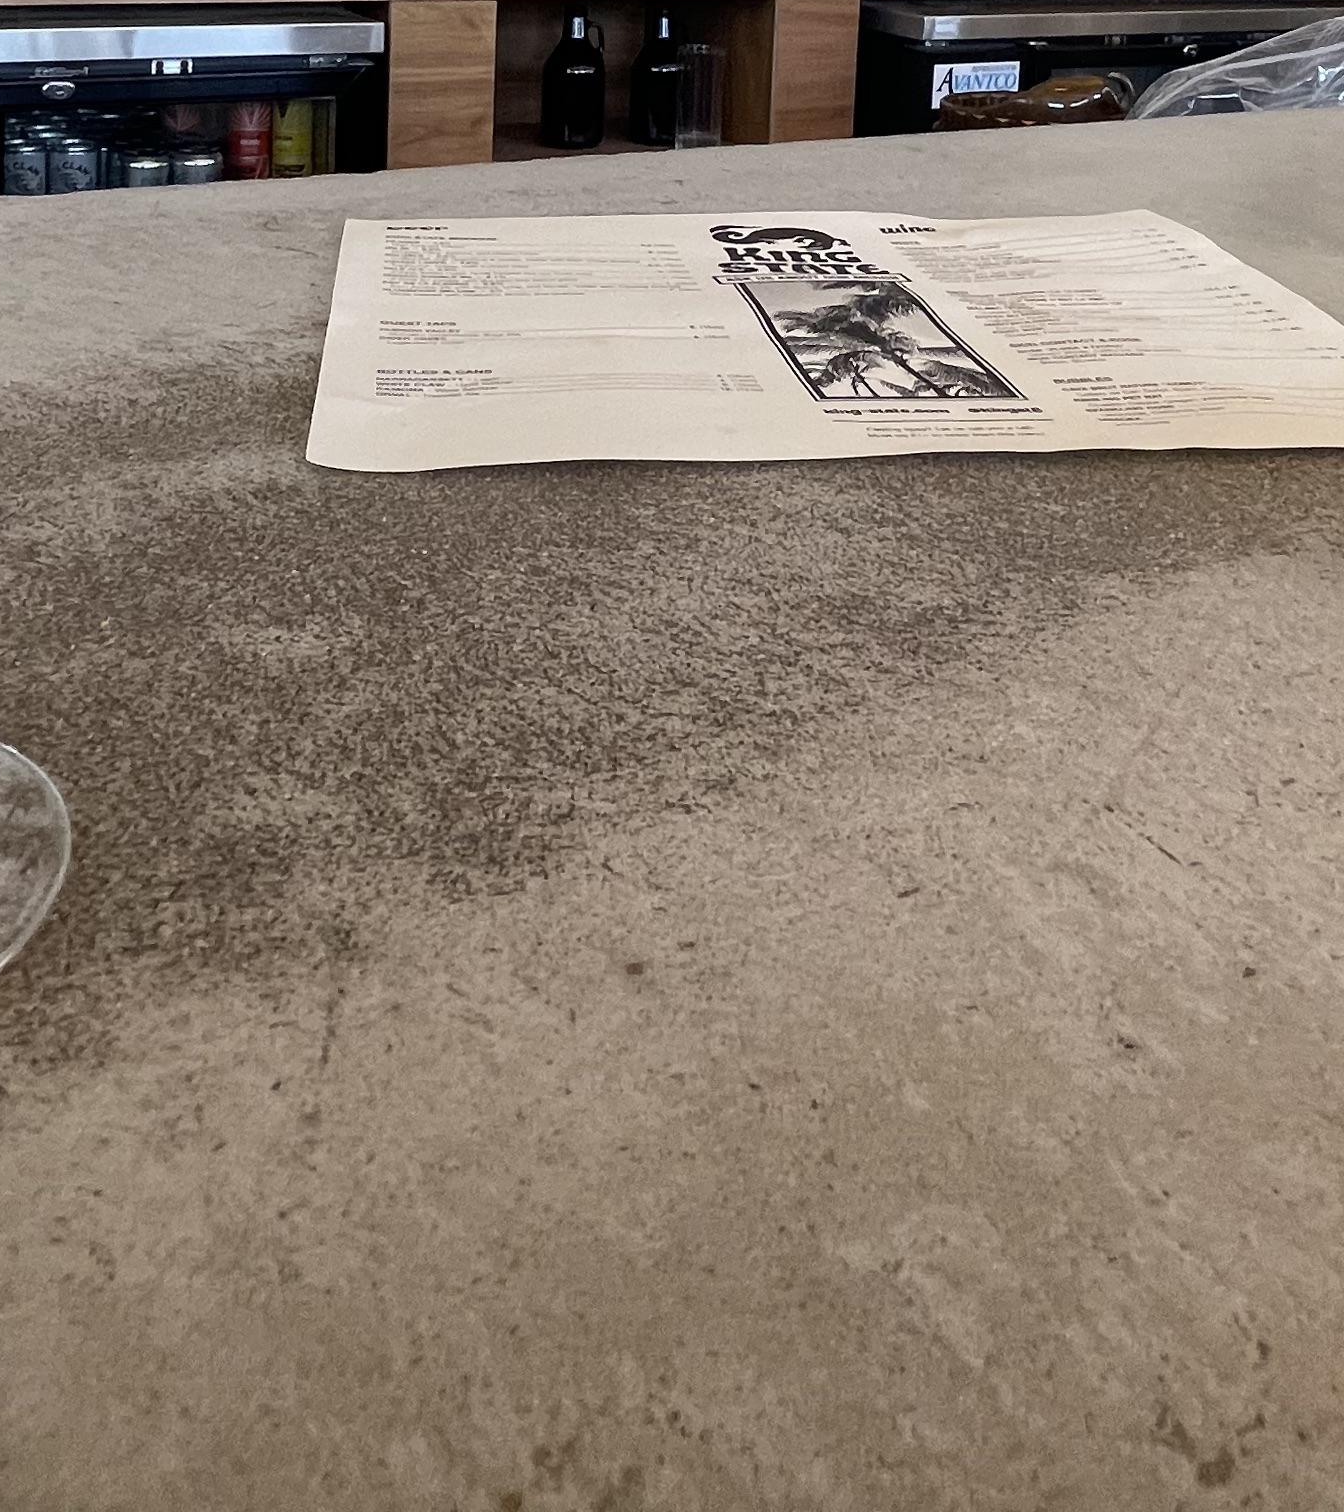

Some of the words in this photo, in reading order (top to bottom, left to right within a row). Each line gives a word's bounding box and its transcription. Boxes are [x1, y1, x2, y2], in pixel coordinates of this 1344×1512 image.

[936, 67, 1017, 94] AVANTCO
[879, 224, 936, 234] wine
[723, 247, 862, 263] KING
[718, 263, 891, 275] STATE
